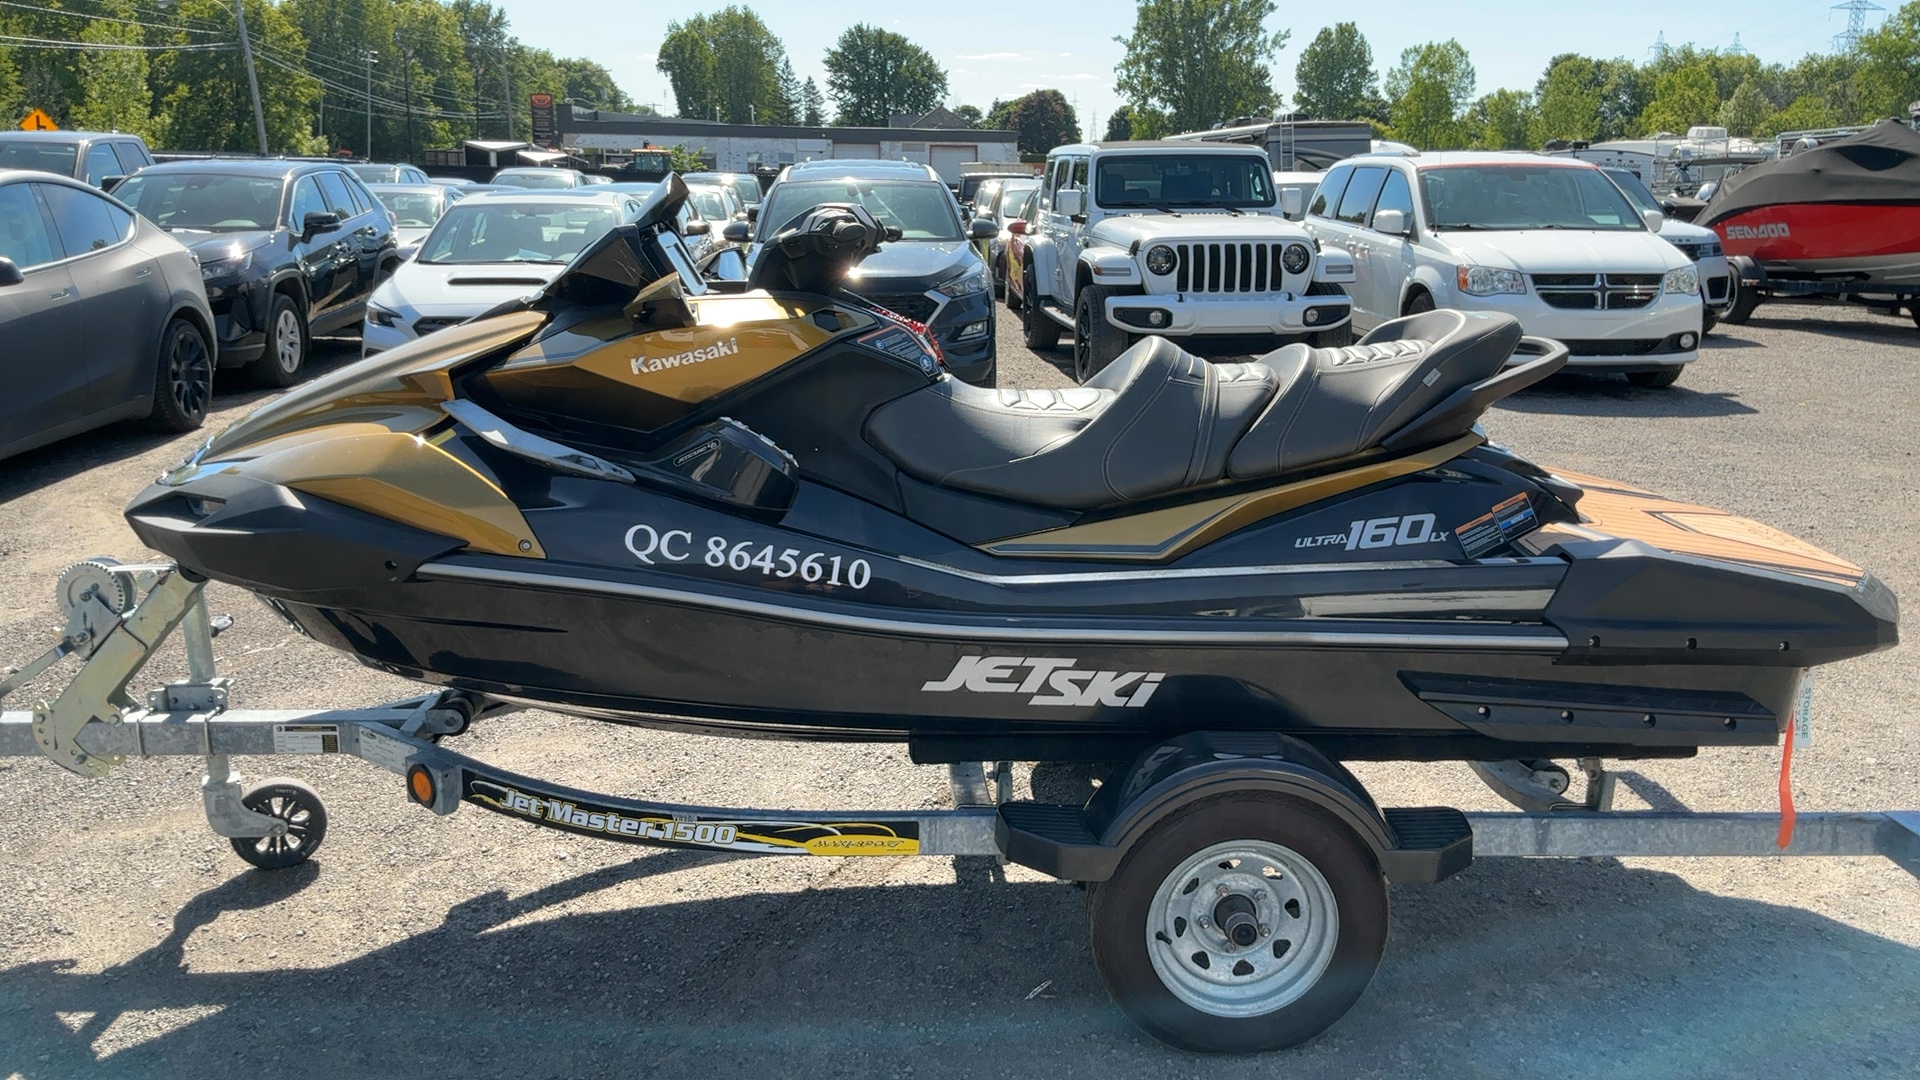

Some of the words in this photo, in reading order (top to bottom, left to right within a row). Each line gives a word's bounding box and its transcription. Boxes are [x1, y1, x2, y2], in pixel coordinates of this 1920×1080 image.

[630, 337, 739, 375] Kawasaki
[624, 524, 692, 565] QC
[704, 536, 871, 589] 8645610
[1294, 533, 1347, 548] ULTRA
[1344, 513, 1436, 550] 160
[1430, 531, 1450, 542] LX
[1801, 687, 1811, 739] STORAGE
[501, 788, 544, 816] Jet
[546, 799, 654, 838] Master
[660, 820, 739, 845] 1500
